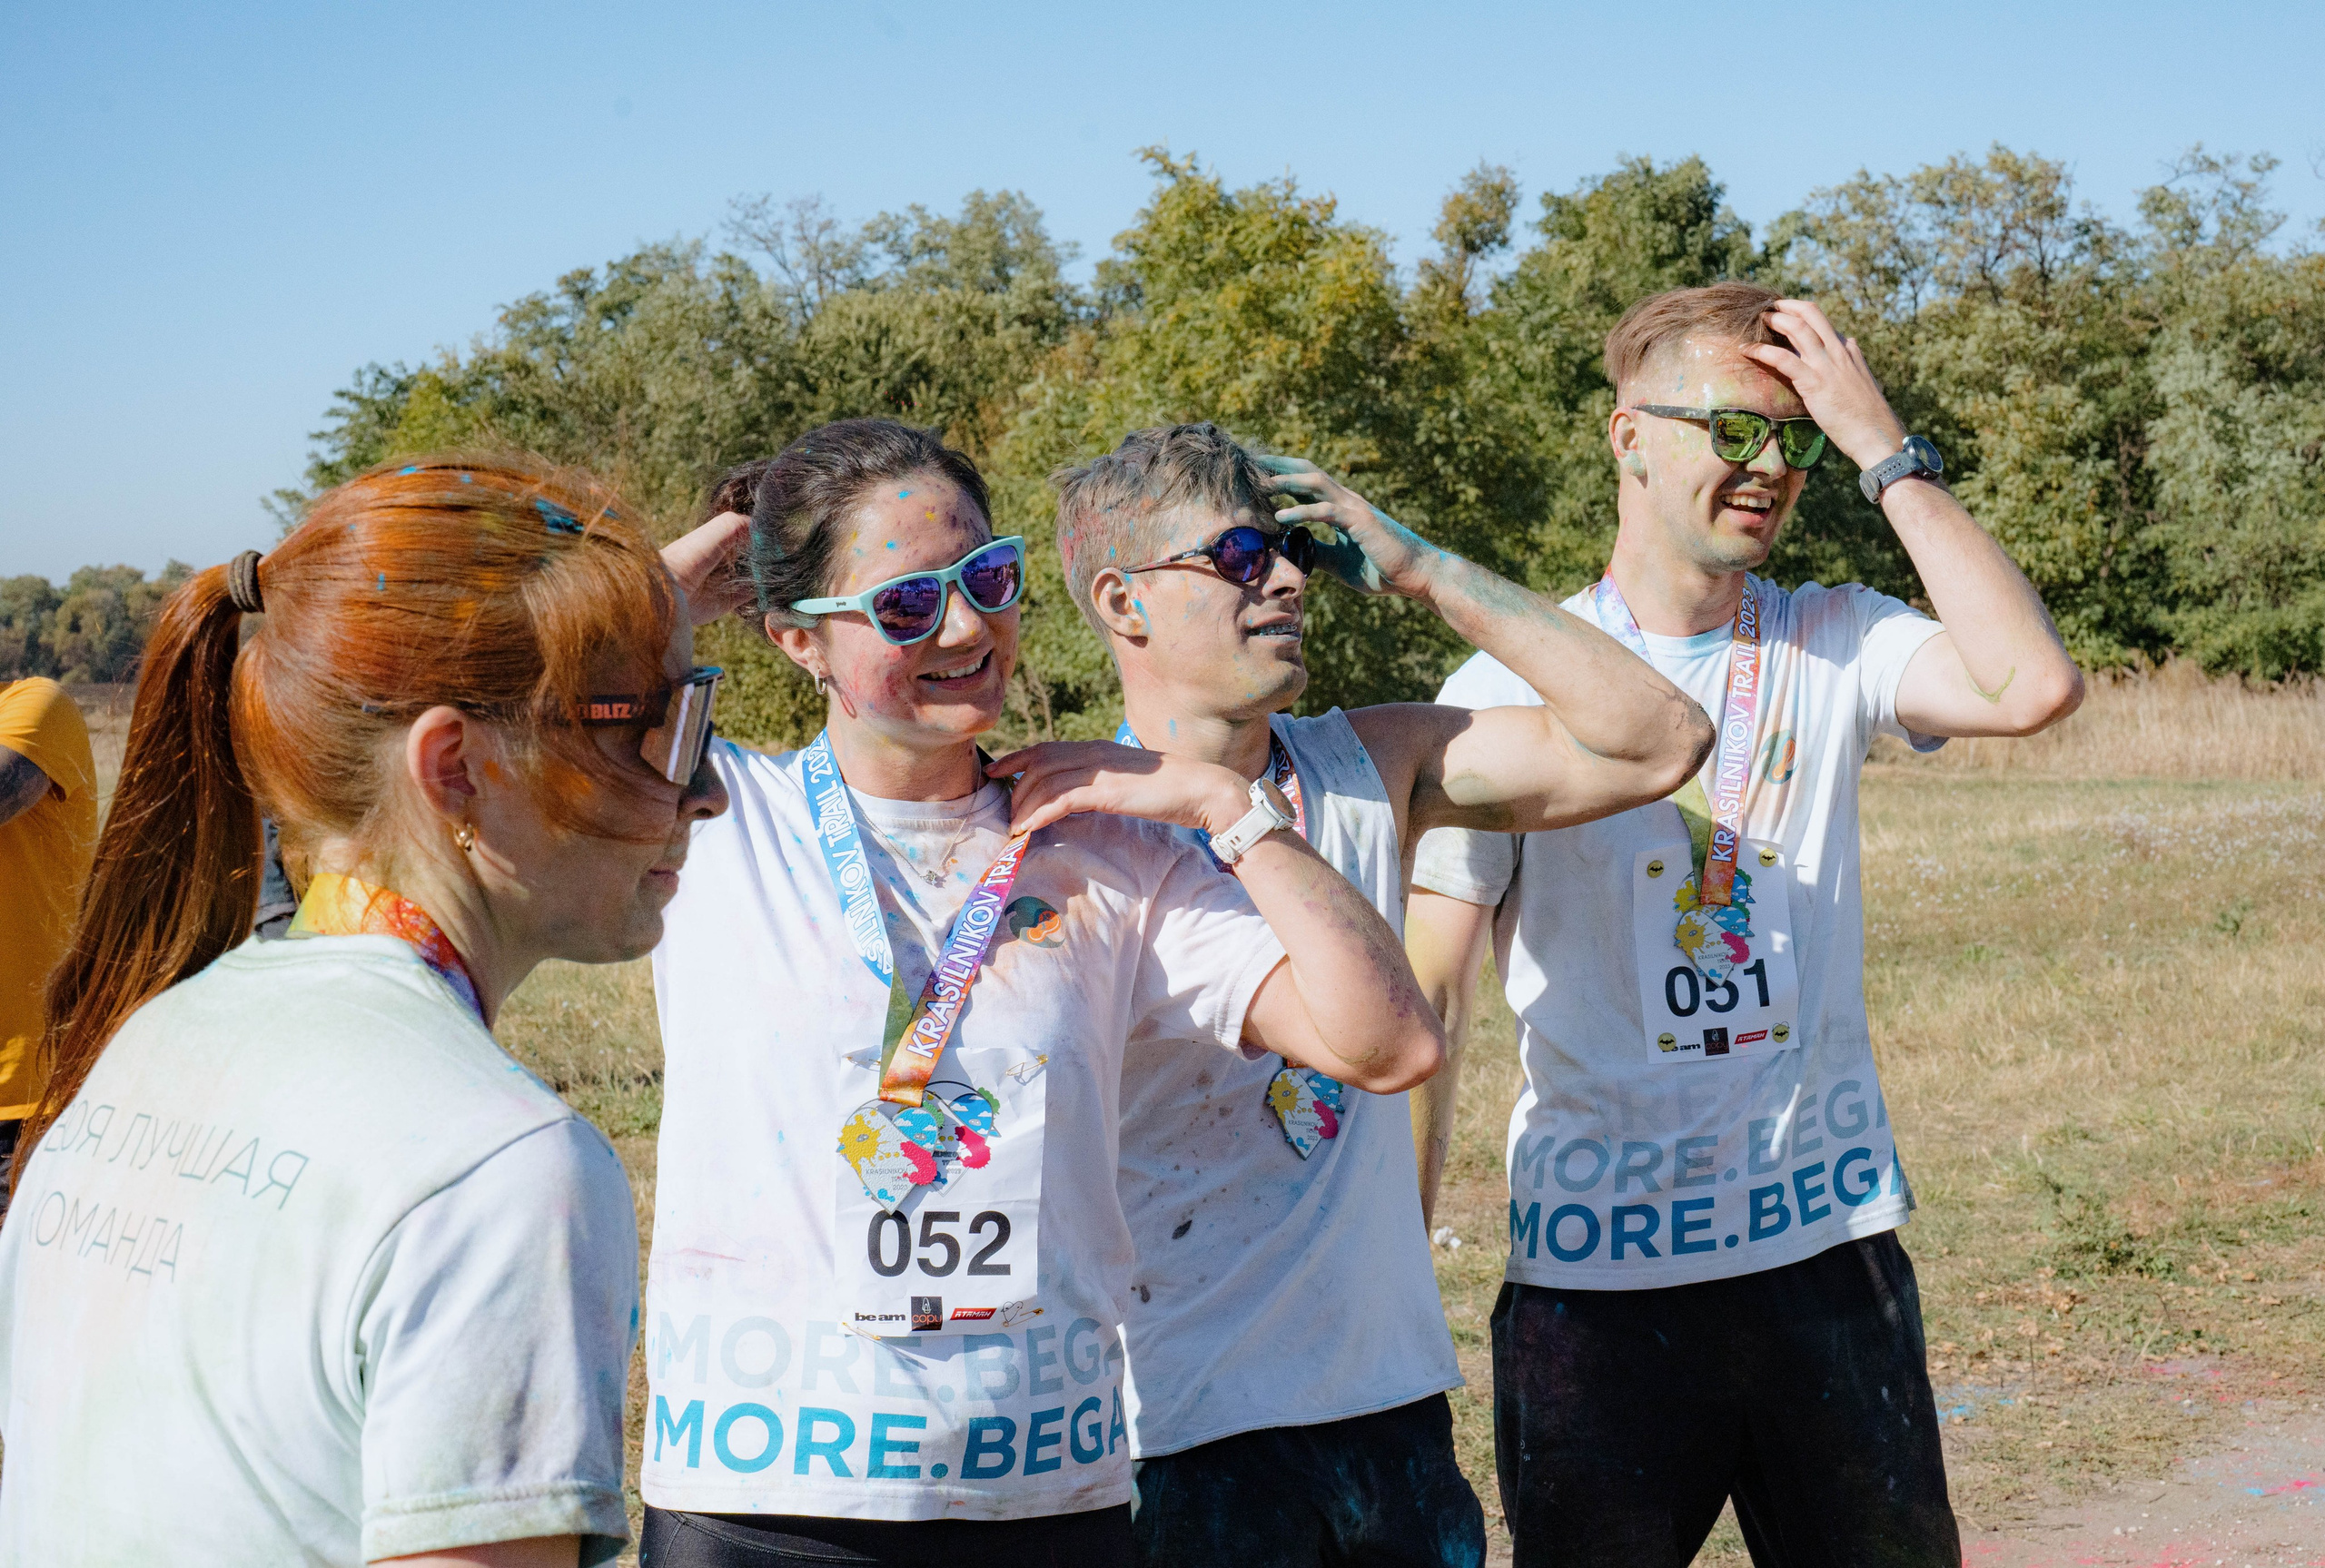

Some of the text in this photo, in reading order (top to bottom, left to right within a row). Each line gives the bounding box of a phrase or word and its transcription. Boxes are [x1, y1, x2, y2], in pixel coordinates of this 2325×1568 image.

[1711, 702, 1750, 863] KRASILNIKOV
[1732, 642, 1756, 698] TRAIL
[815, 779, 853, 848] TRAIL
[906, 831, 1030, 1059] KRASILNIKOV TRAIL
[1666, 959, 1770, 1017] 051
[108, 1112, 310, 1211] ЛУЧШАЯ
[867, 1210, 1012, 1277] 052
[911, 1314, 943, 1326] copy
